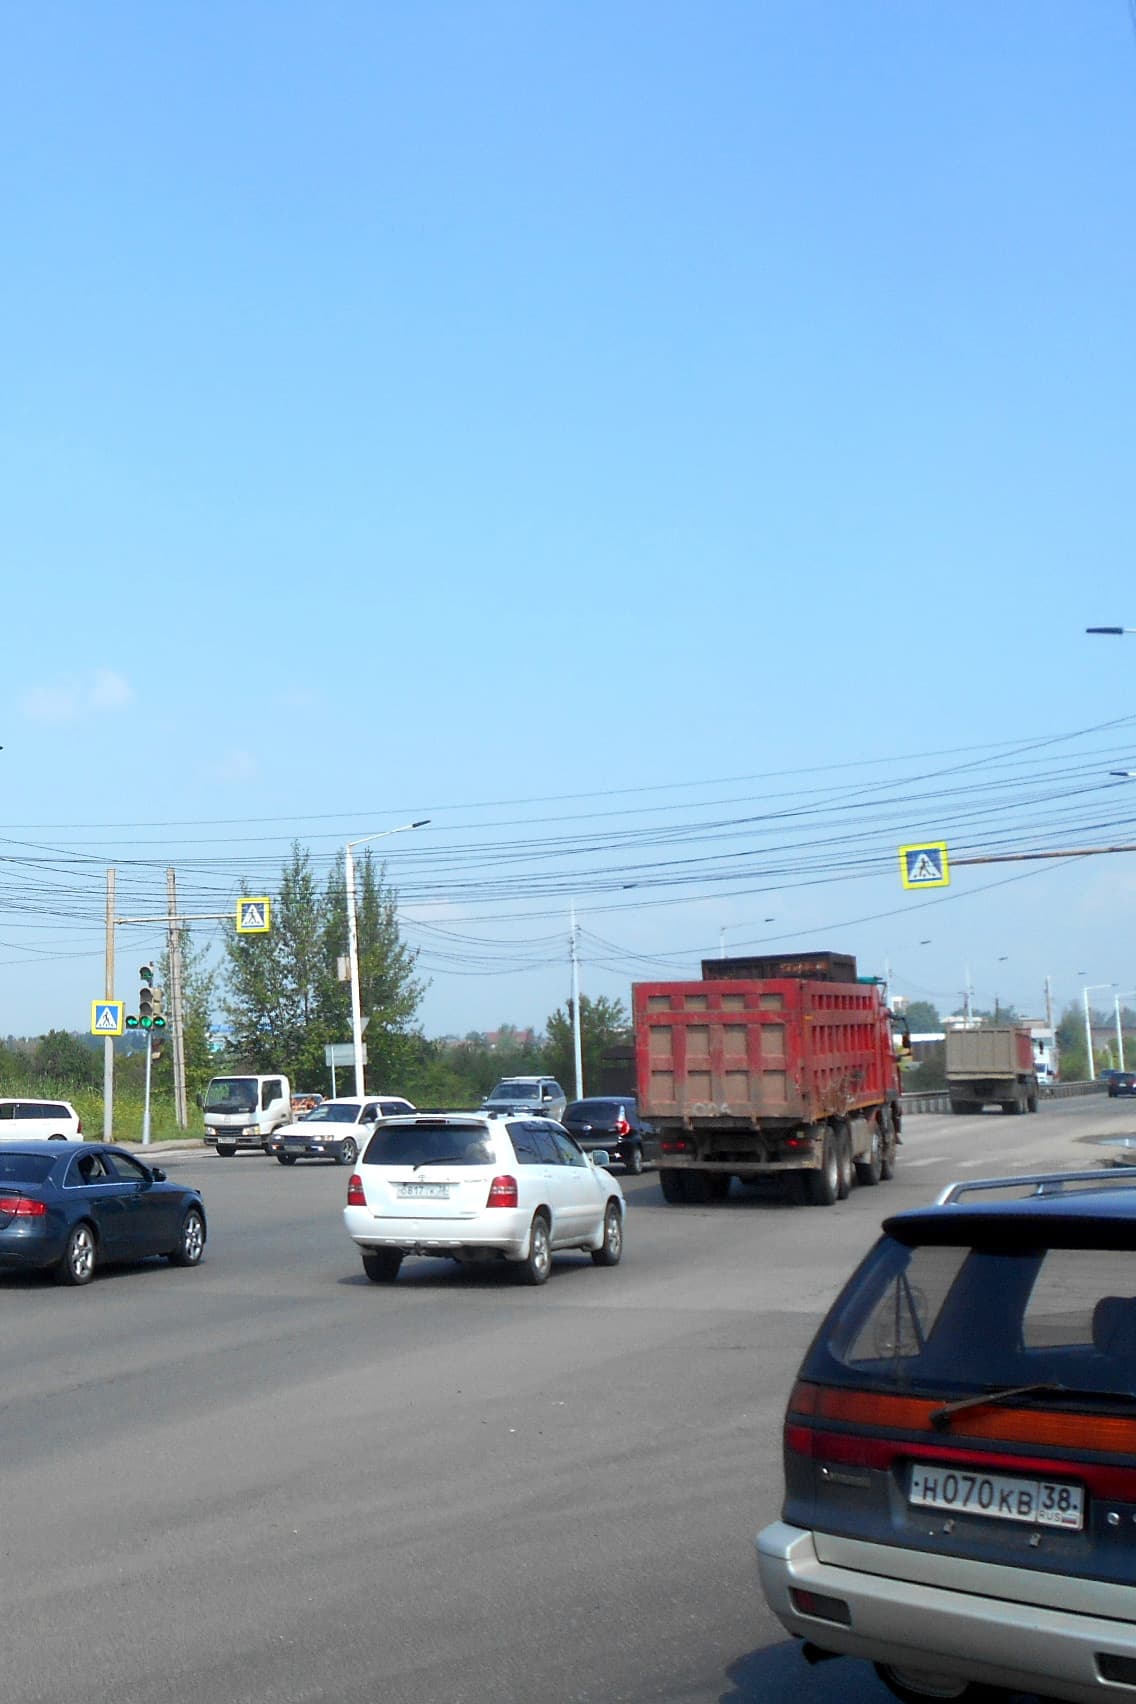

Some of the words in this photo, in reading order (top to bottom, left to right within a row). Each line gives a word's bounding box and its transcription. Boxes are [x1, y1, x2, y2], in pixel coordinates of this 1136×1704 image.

[922, 1474, 1033, 1516] Н070КВ
[1041, 1485, 1072, 1512] 38
[1039, 1511, 1062, 1522] RUS
